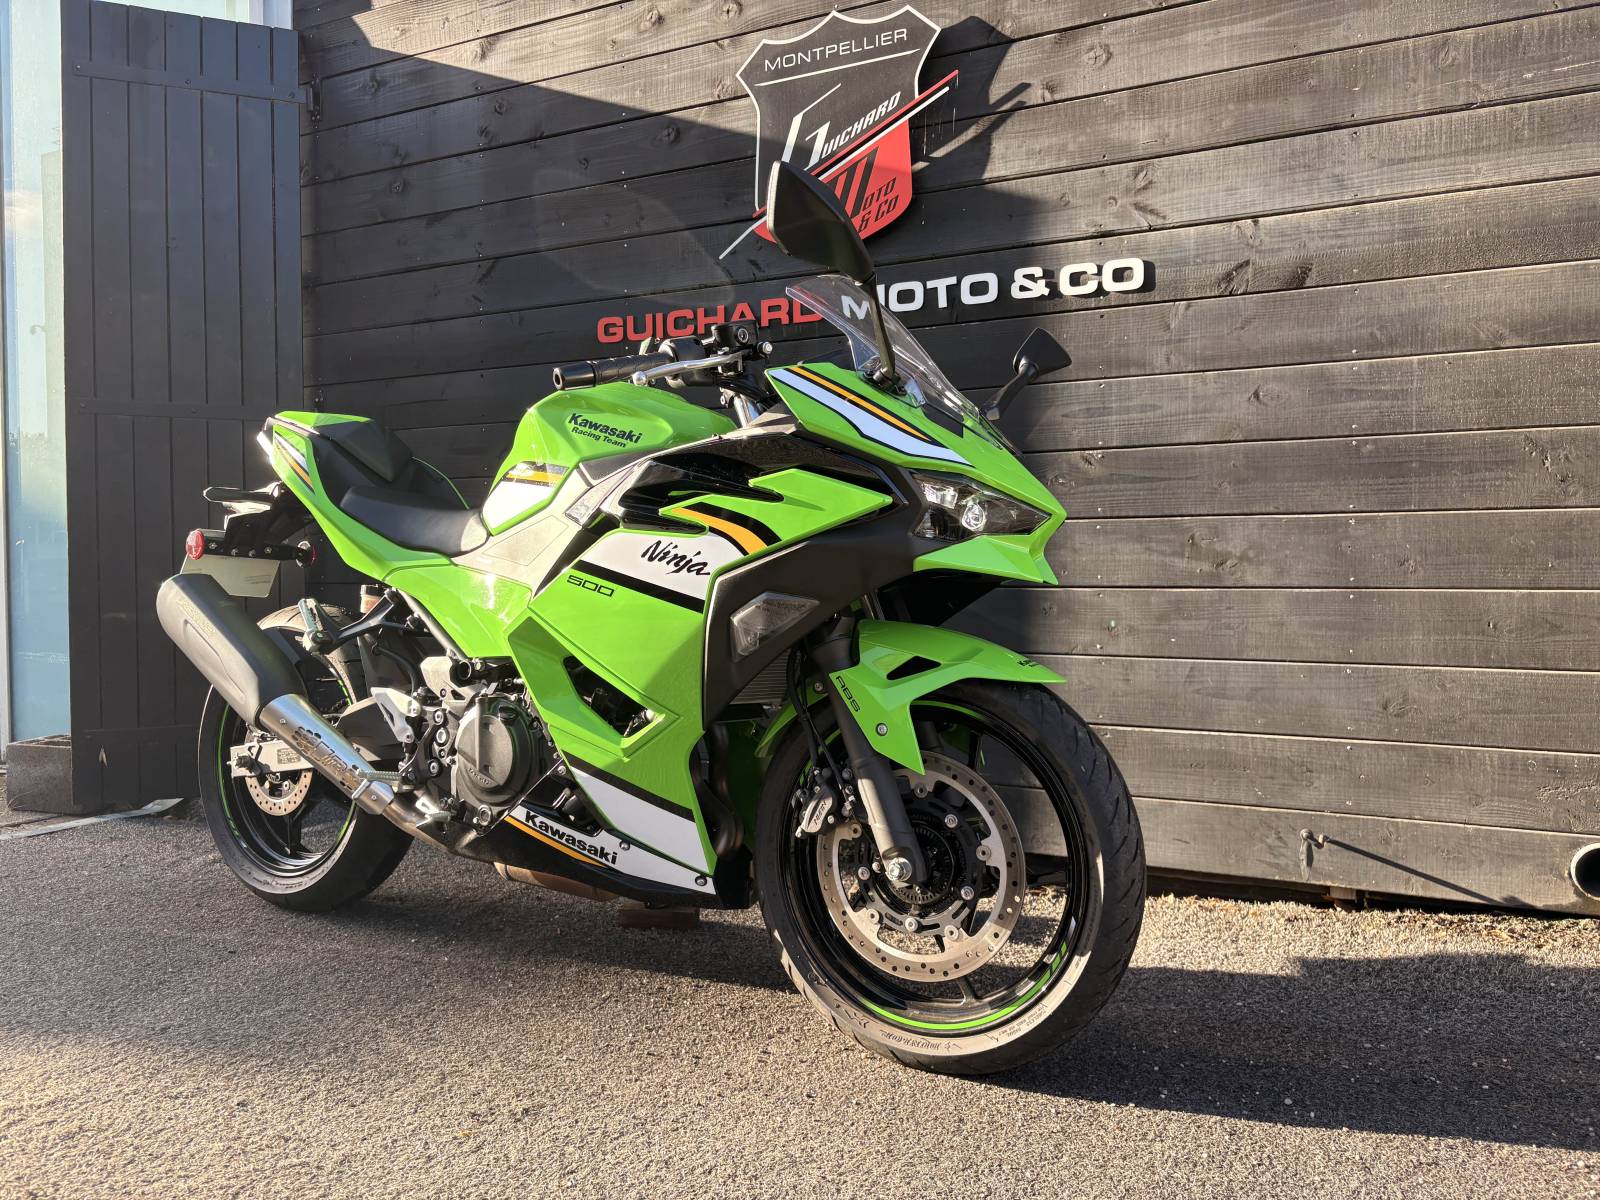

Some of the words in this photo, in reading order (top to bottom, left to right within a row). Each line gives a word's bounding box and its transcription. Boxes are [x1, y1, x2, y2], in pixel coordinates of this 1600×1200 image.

[764, 28, 908, 72] MONTPELLIER
[874, 195, 899, 222] CO
[597, 285, 826, 344] GUICHARD
[841, 271, 999, 321] MOTO
[1010, 266, 1050, 299] &
[1058, 257, 1145, 297] CO
[568, 412, 643, 444] Kawasaki
[571, 426, 601, 442] Racing
[603, 432, 627, 449] Team
[640, 539, 711, 576] Ninja
[567, 574, 615, 598] 500
[836, 675, 861, 712] ABS
[523, 809, 618, 866] Kawasaki
